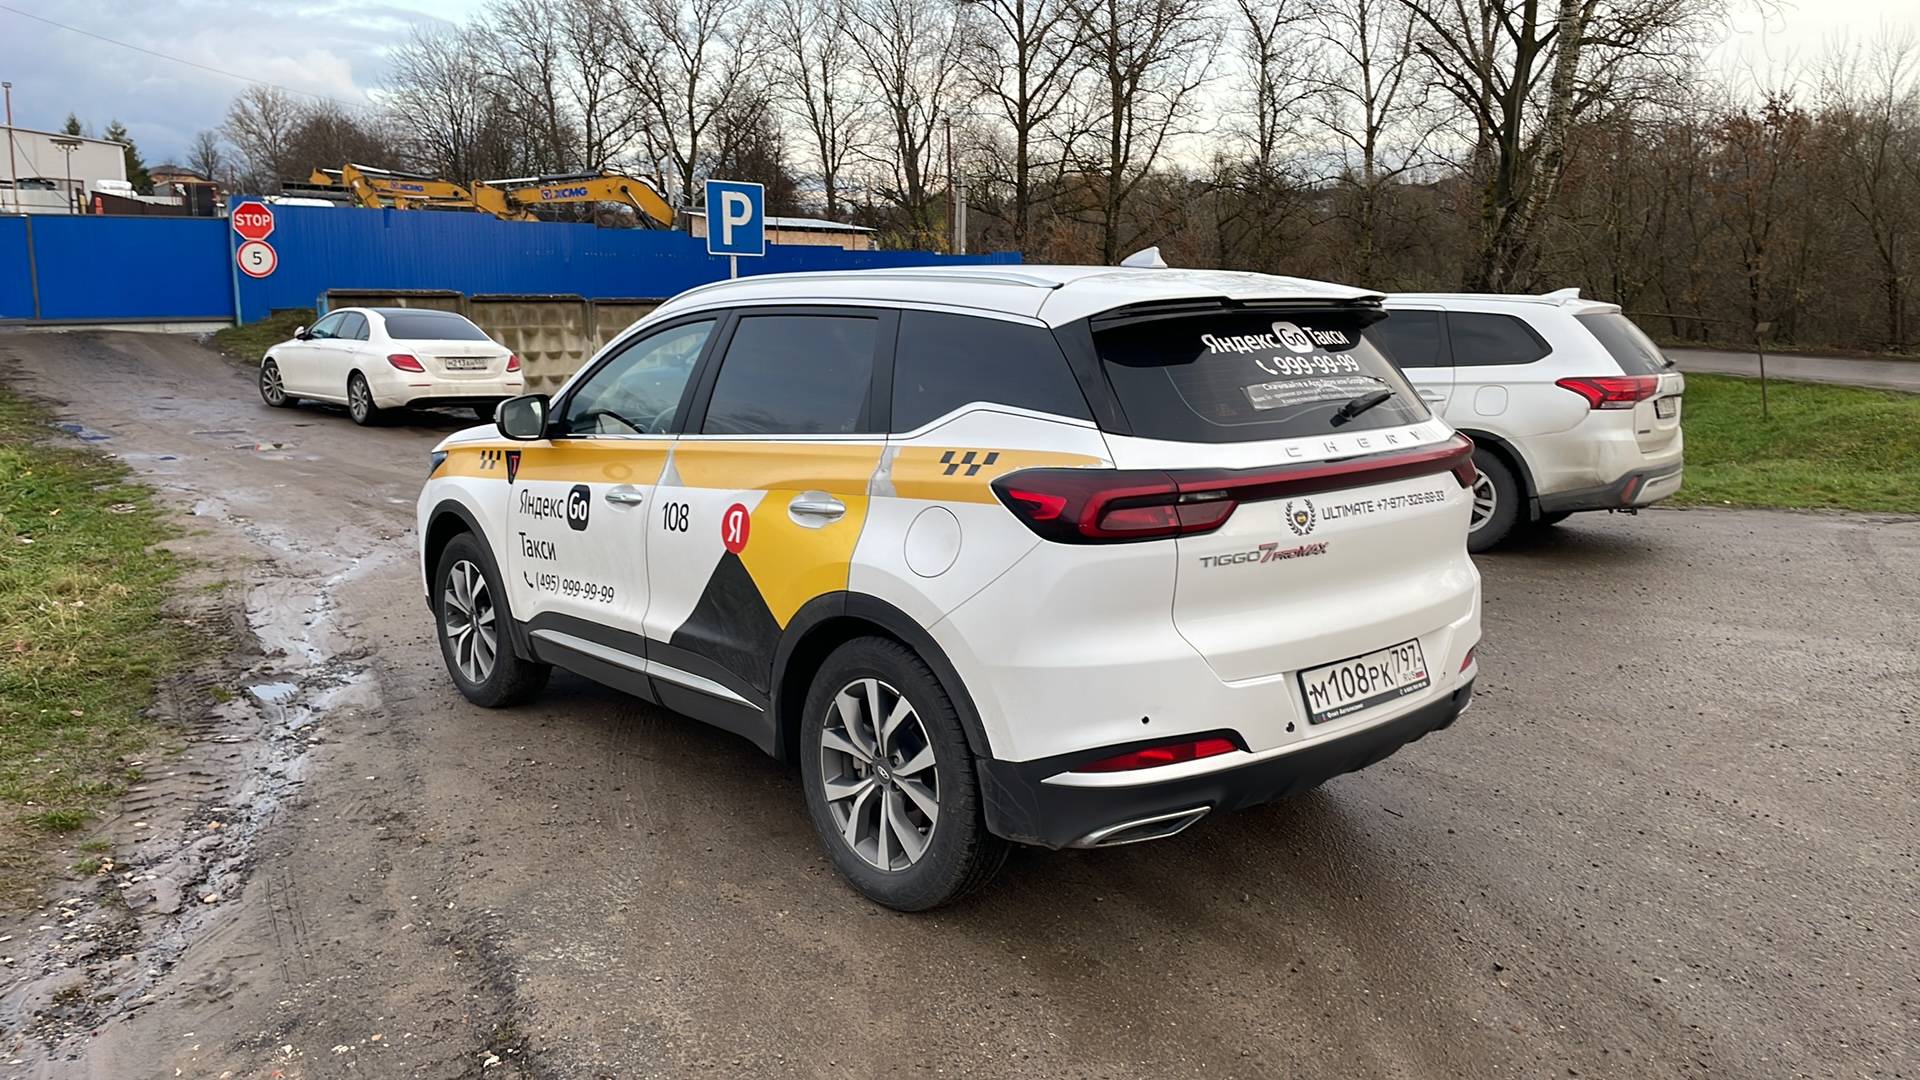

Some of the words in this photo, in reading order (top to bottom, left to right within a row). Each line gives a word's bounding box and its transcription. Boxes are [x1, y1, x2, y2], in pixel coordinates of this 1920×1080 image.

[554, 187, 588, 198] XCMG
[235, 213, 271, 227] STOP
[721, 190, 753, 246] P
[252, 251, 263, 265] 5
[1201, 333, 1281, 354] Яндекс
[1279, 327, 1306, 346] Go
[1302, 326, 1351, 346] Такси
[1272, 354, 1360, 376] 999-99-99
[1285, 430, 1421, 458] CHERY
[519, 488, 564, 520] Яндекс
[568, 491, 588, 521] Go
[662, 502, 689, 533] 108
[1322, 499, 1374, 520] ULTIMATE
[727, 510, 744, 544] Я
[518, 531, 557, 561] Такси
[535, 571, 560, 595] (495)
[562, 578, 615, 604] 999-99-99
[1391, 644, 1417, 674] 797
